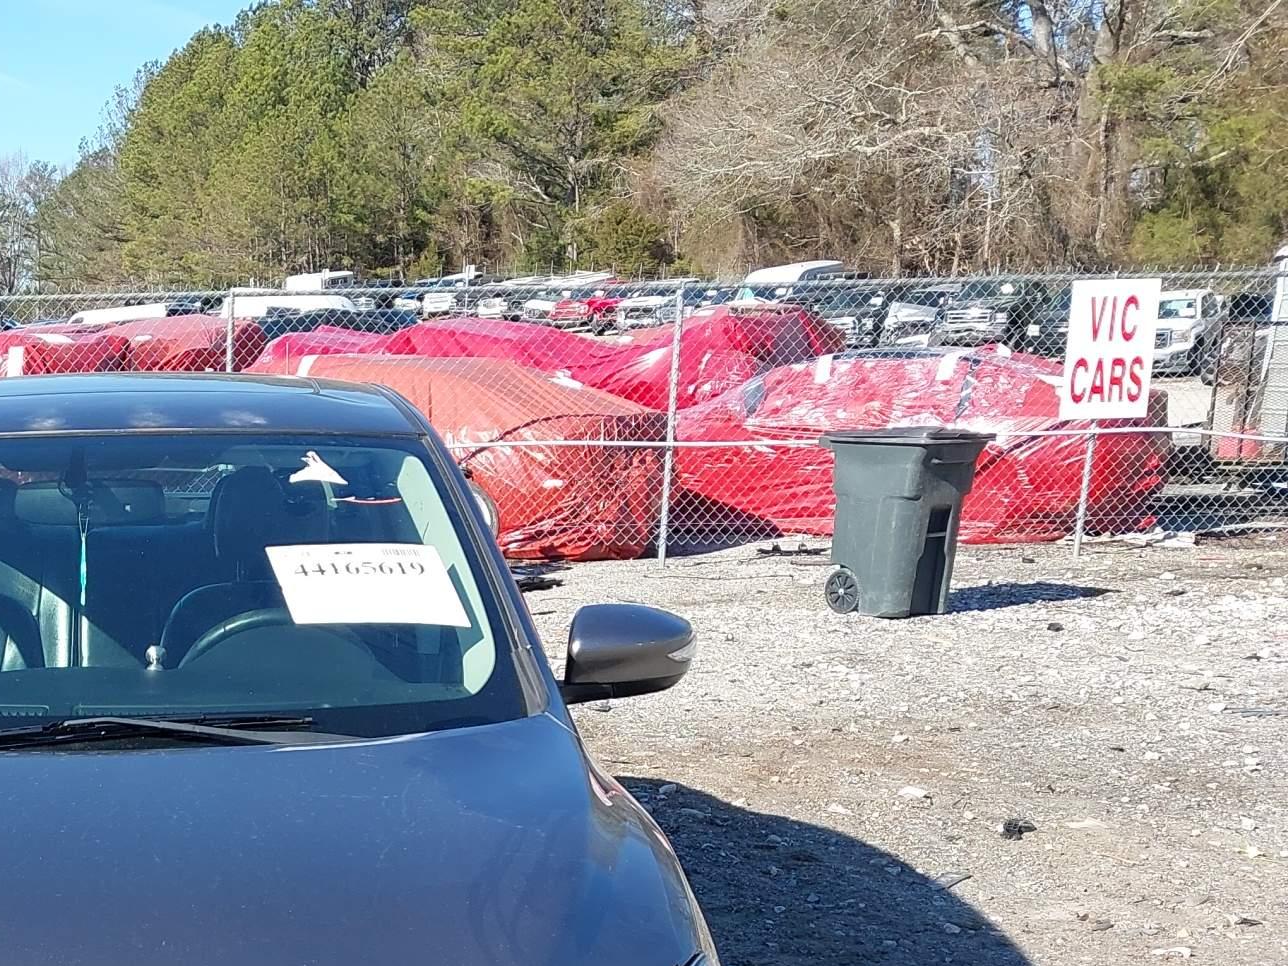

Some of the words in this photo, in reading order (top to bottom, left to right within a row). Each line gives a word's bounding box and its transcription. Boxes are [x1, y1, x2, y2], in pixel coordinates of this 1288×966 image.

[1090, 294, 1140, 342] VIC
[1070, 356, 1145, 404] CARS
[294, 561, 425, 577] 44165619
